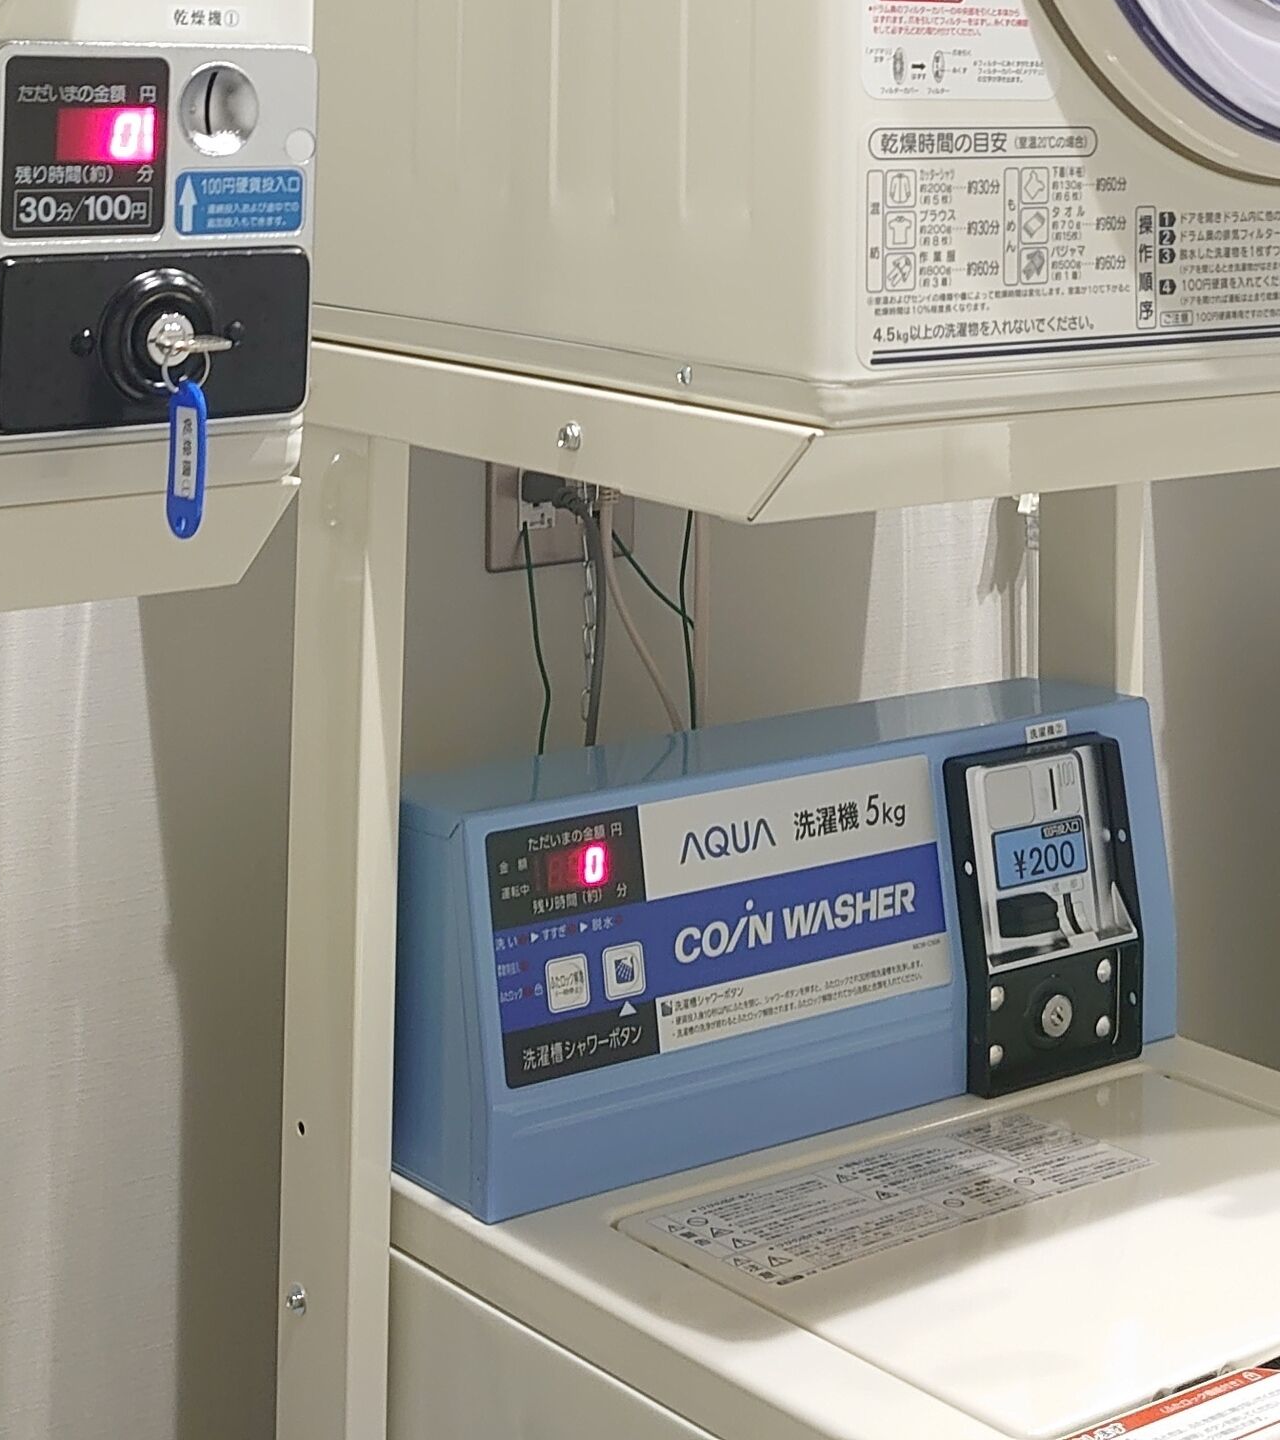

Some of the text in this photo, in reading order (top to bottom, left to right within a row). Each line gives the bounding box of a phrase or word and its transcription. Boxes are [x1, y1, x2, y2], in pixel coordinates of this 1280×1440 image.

[173, 9, 241, 28] 乾燥機①
[16, 84, 157, 103] ただいまの金額 円
[880, 132, 1008, 155] 乾燥時間の目安
[15, 164, 155, 185] 残り時間(約) 分
[1095, 175, 1127, 192] 約60分
[967, 179, 1001, 196] 約30分
[19, 194, 148, 223] 30分/100円
[919, 209, 957, 223] ブラウス
[1051, 206, 1085, 218] タオル
[967, 219, 1001, 236] 約30分
[1095, 215, 1127, 231] 約60分
[966, 260, 1000, 277] 約60分
[1095, 255, 1126, 271] 約60分
[1138, 214, 1153, 322] 操作順序
[872, 315, 1095, 344] 4.5kg以上の洗濯物を入れないでください。
[793, 793, 907, 842] 洗濯機 5kg
[527, 822, 623, 853] ただいまの金額 円
[679, 817, 777, 865] AQUA
[583, 845, 605, 885] 0
[1012, 839, 1075, 880] ¥200
[616, 882, 628, 899] 分
[782, 881, 916, 940] WASHER
[522, 1025, 643, 1071] 洗濯槽シャワーボタン
